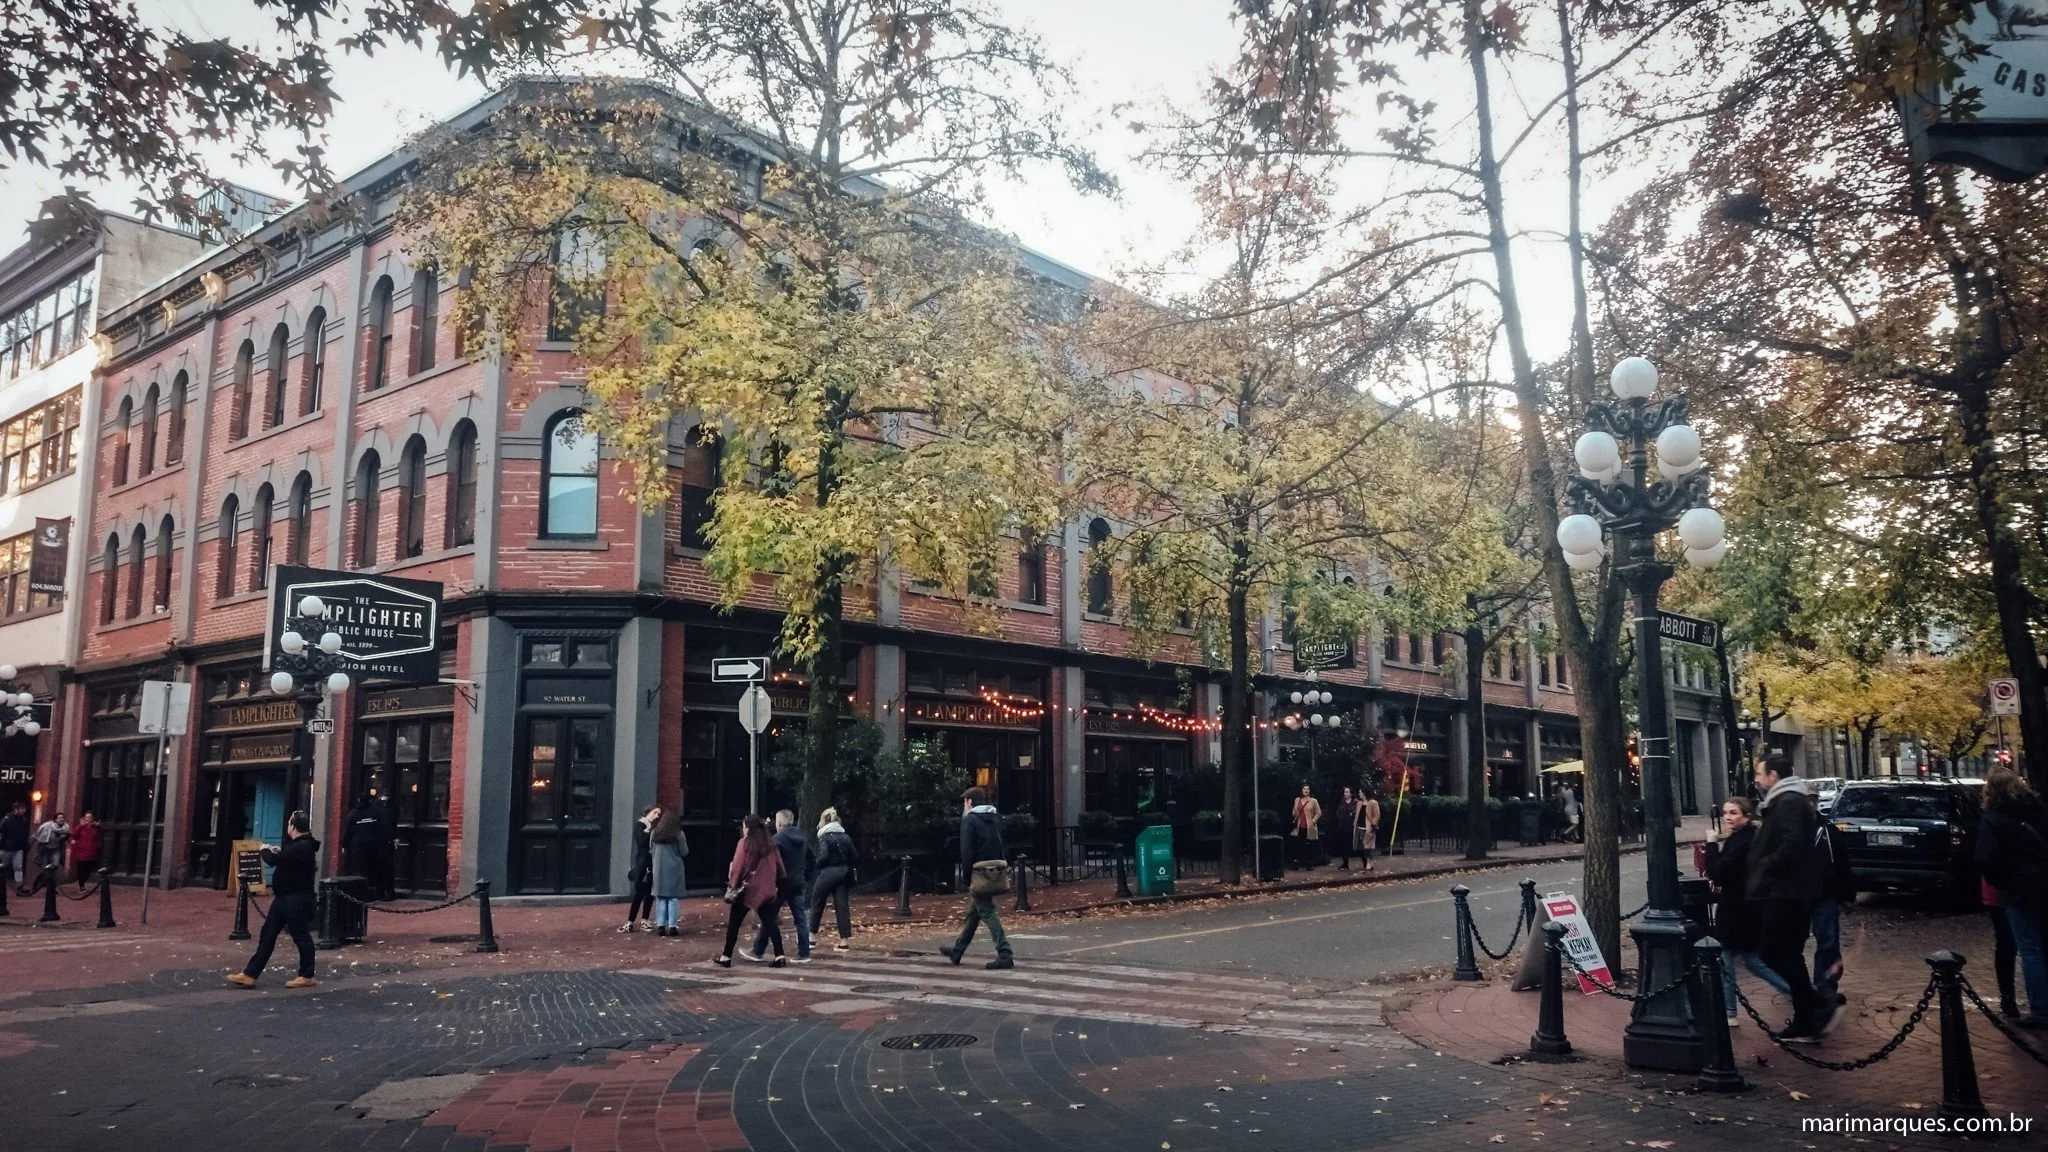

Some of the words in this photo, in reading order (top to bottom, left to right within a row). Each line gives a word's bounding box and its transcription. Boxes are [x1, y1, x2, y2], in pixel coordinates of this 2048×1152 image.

[1994, 61, 2047, 98] GAS
[355, 596, 370, 605] THE
[296, 601, 423, 629] LMPLIGHTER
[326, 624, 361, 637] PBLIC
[365, 628, 394, 639] HOUSE
[1660, 615, 1697, 640] ABBOTT
[371, 663, 405, 673] HOTEL
[228, 702, 297, 725] LAMPLIGHTER
[926, 702, 1023, 725] LAMPLIGHTER
[1567, 936, 1594, 955] KEPKAY
